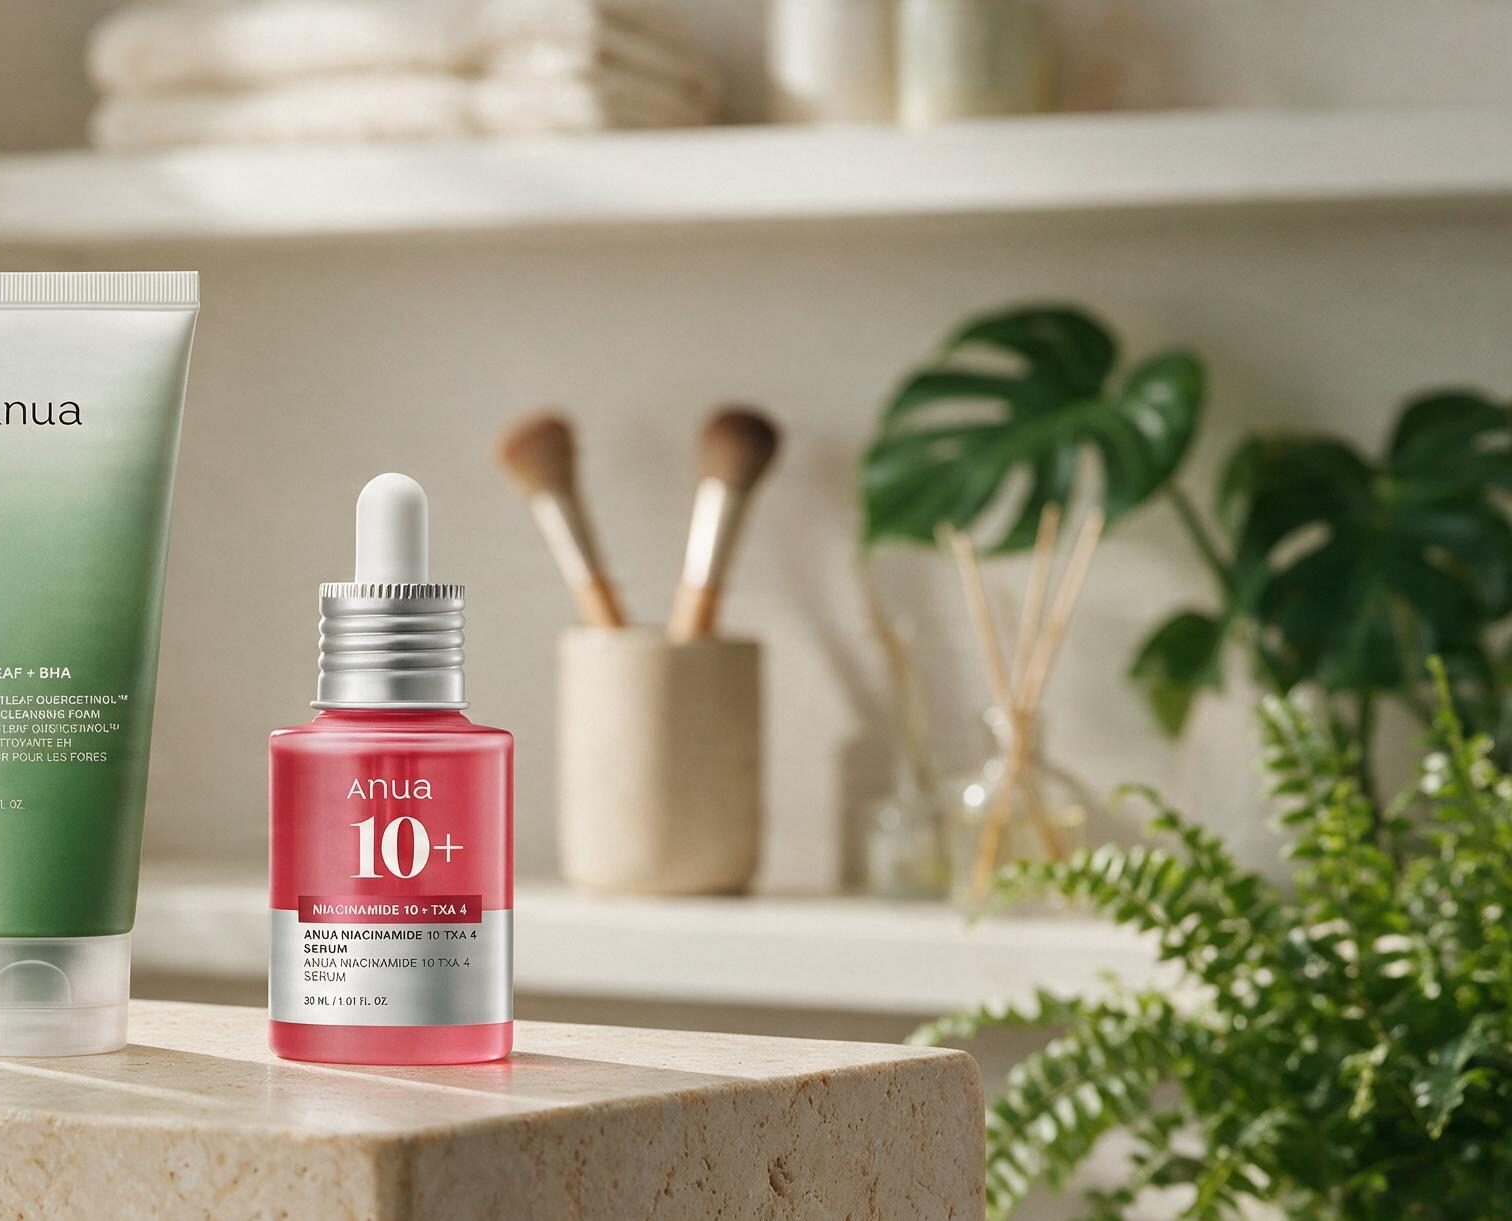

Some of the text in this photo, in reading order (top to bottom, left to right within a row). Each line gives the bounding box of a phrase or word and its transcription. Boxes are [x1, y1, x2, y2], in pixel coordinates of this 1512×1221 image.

[27, 669, 35, 678] +
[40, 667, 72, 679] BHA
[68, 710, 101, 720] FOAM
[12, 752, 43, 762] POUR
[47, 752, 67, 762] LES
[347, 778, 433, 800] Anua
[313, 904, 399, 915] NIACINAMIDE
[404, 904, 418, 915] 10
[431, 904, 456, 915] TXA
[459, 904, 467, 915] 4
[304, 930, 477, 940] ANUA NIACINAMIDE 10 TXA 4
[304, 944, 348, 954] SERUM
[304, 958, 470, 968] ANUA NIACINAMIDE 10 TXA 4
[304, 971, 346, 982] SERUM
[304, 996, 315, 1006] 30
